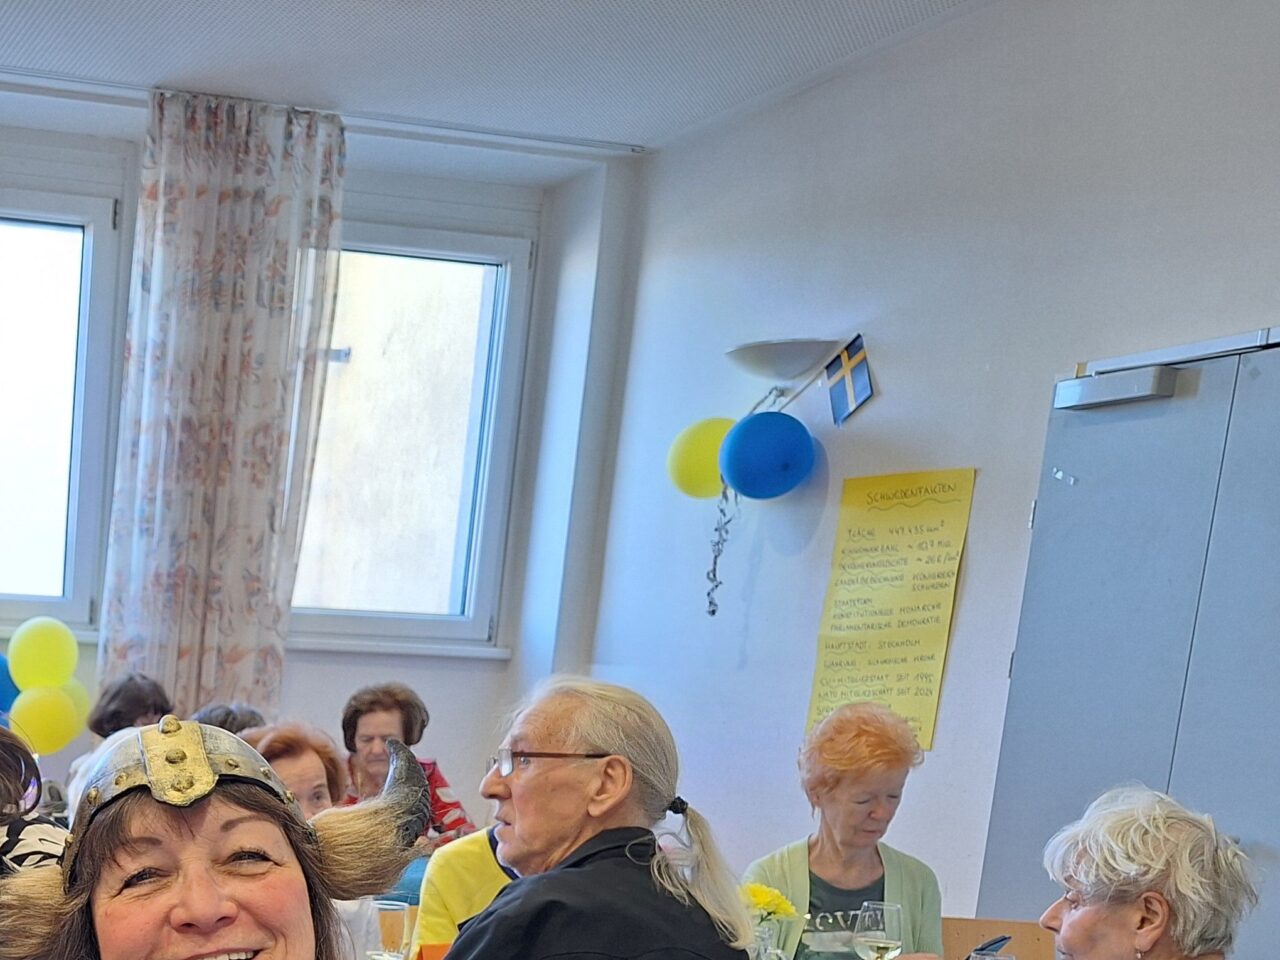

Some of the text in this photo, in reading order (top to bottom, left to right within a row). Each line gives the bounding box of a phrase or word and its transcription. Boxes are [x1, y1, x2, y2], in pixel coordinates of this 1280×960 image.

[867, 483, 956, 505] SCHWEDENFAKTEN
[878, 639, 921, 650] STOCKHOLM
[896, 672, 910, 683] SEIT
[897, 687, 911, 697] SEIT
[914, 687, 934, 697] 2024
